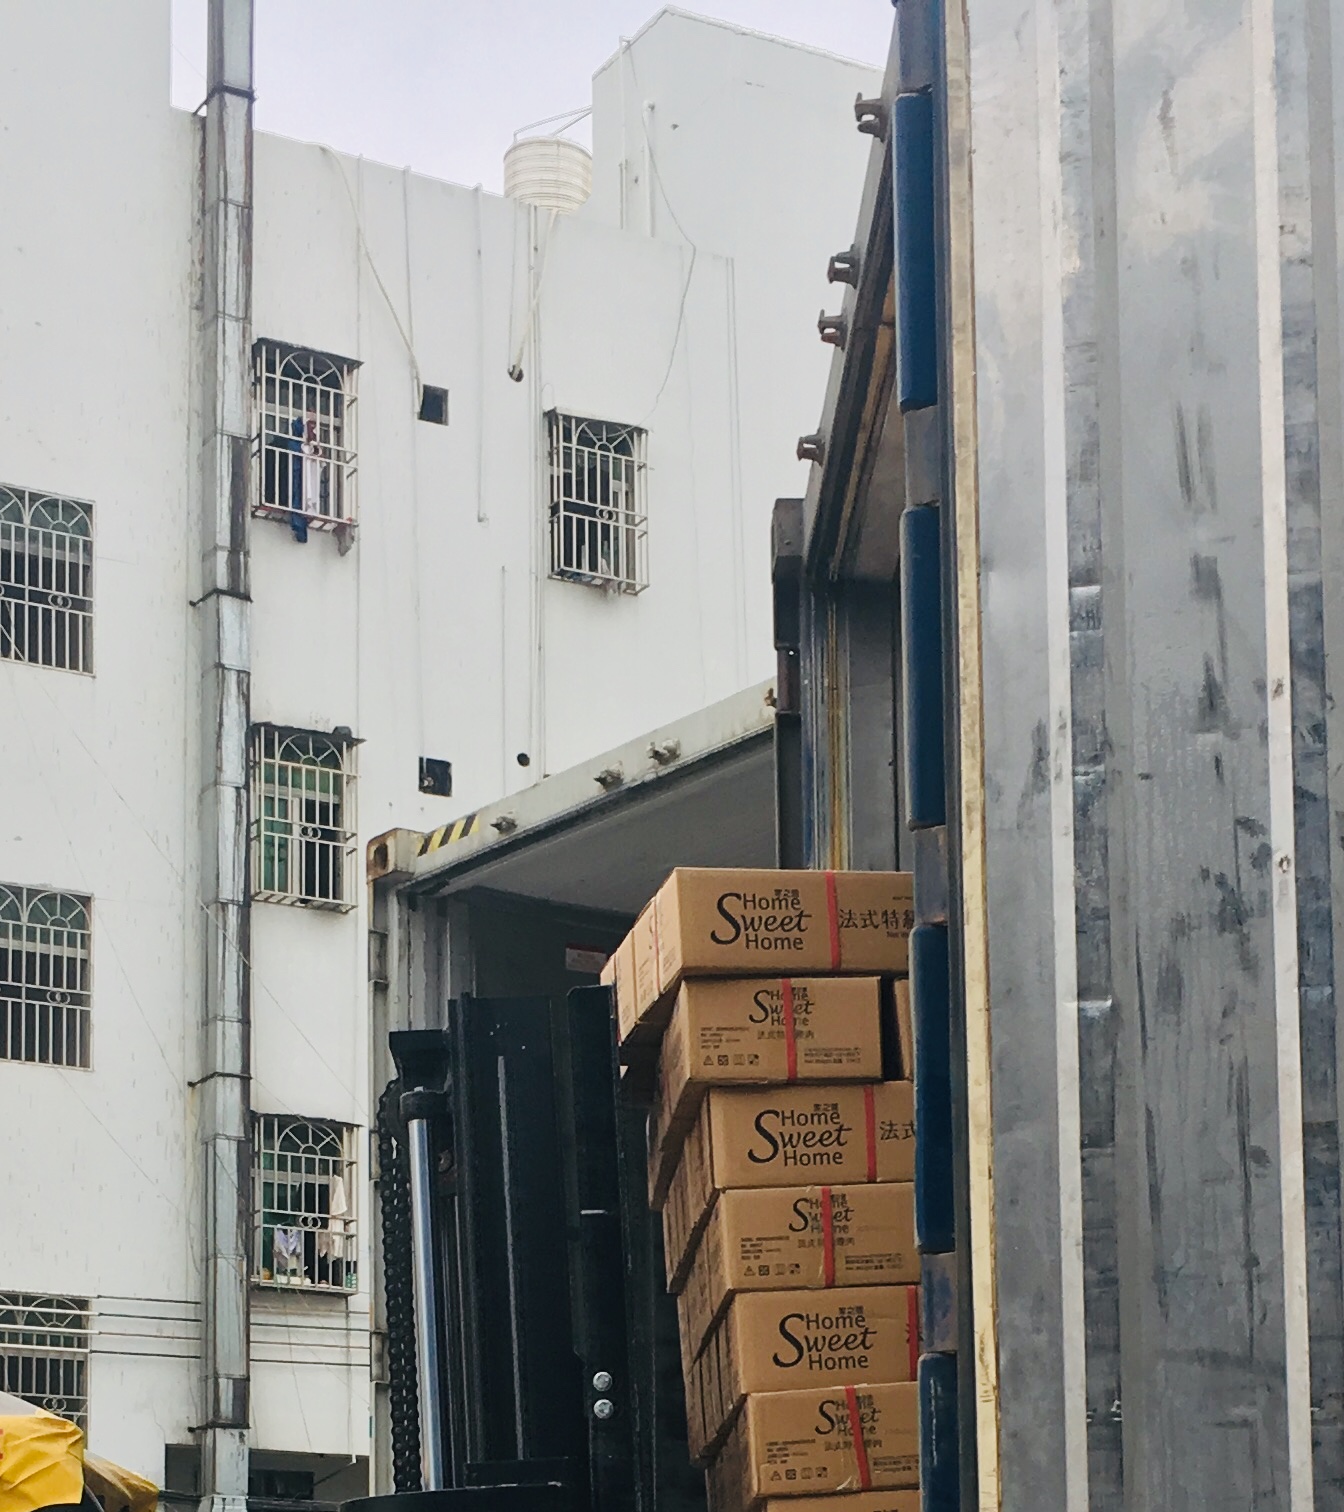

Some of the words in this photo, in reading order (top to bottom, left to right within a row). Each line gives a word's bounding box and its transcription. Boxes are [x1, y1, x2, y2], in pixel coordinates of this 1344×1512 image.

[742, 893, 801, 911] Home
[710, 892, 812, 945] Sweet
[745, 933, 804, 950] Home
[749, 989, 815, 1024] Swet
[781, 1110, 841, 1126] Home
[748, 1109, 852, 1163] Sweet
[783, 1150, 843, 1167] Home
[789, 1197, 855, 1232] Swet
[805, 1313, 866, 1330] Home
[772, 1313, 878, 1368] Sweet
[808, 1354, 869, 1371] Home
[815, 1400, 881, 1435] Swet
